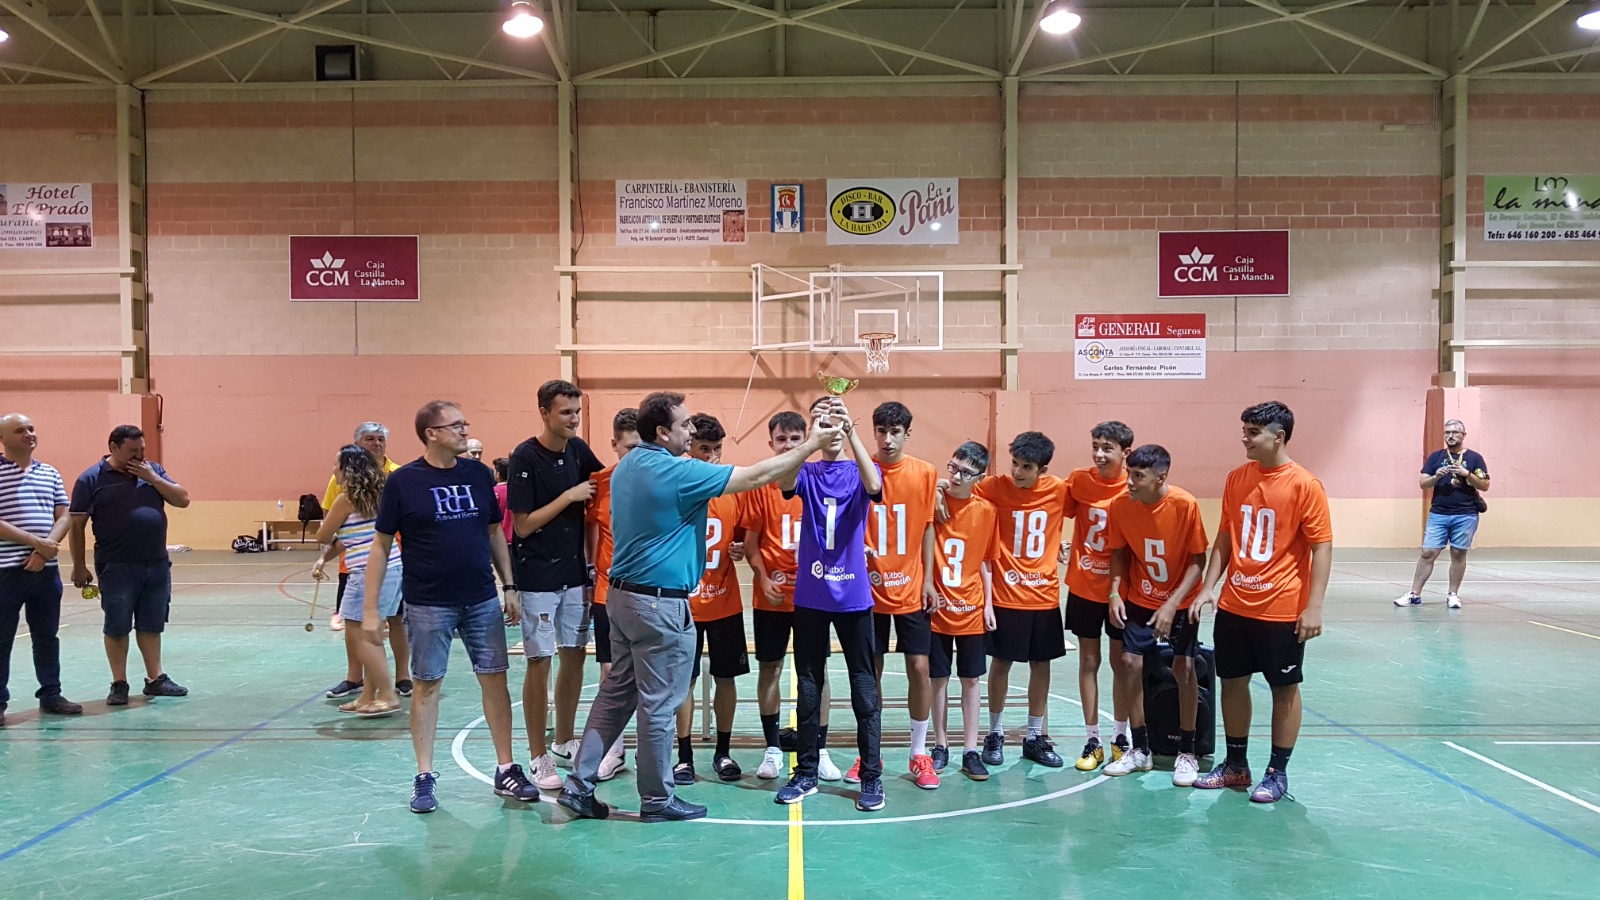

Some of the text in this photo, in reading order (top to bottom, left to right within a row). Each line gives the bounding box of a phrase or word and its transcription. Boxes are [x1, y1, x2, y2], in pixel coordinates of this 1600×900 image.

[26, 185, 79, 199] Hotel
[625, 180, 678, 194] CARPINTERÍA
[685, 180, 736, 193] EBANISTERÍA
[926, 182, 943, 203] La
[620, 195, 742, 209] Francisco Martínez Moreno
[841, 194, 862, 204] DISCO
[868, 194, 883, 204] BAR
[1493, 187, 1521, 209] la
[12, 201, 89, 216] El Prado
[850, 203, 874, 220] H
[899, 187, 954, 236] Pani
[662, 215, 666, 223] DE
[667, 215, 682, 223] PUERTAS
[686, 215, 703, 223] PORTONES
[704, 214, 720, 223] RÚSTICOS
[840, 218, 887, 232] LA HACIENDA
[366, 261, 385, 270] Caja
[1236, 256, 1254, 265] Caja
[355, 269, 385, 278] Castilla
[1174, 266, 1218, 282] CCM
[1223, 265, 1254, 273] Castilla
[306, 270, 350, 286] CCM
[1099, 322, 1160, 336] GENERALI
[1167, 326, 1201, 337] Seguros
[823, 498, 836, 550] 1
[874, 504, 906, 556] 11
[1012, 510, 1048, 558] 18
[1239, 504, 1275, 562] 10
[942, 538, 965, 588] 3
[1144, 538, 1169, 583] 5
[824, 573, 855, 581] emotion
